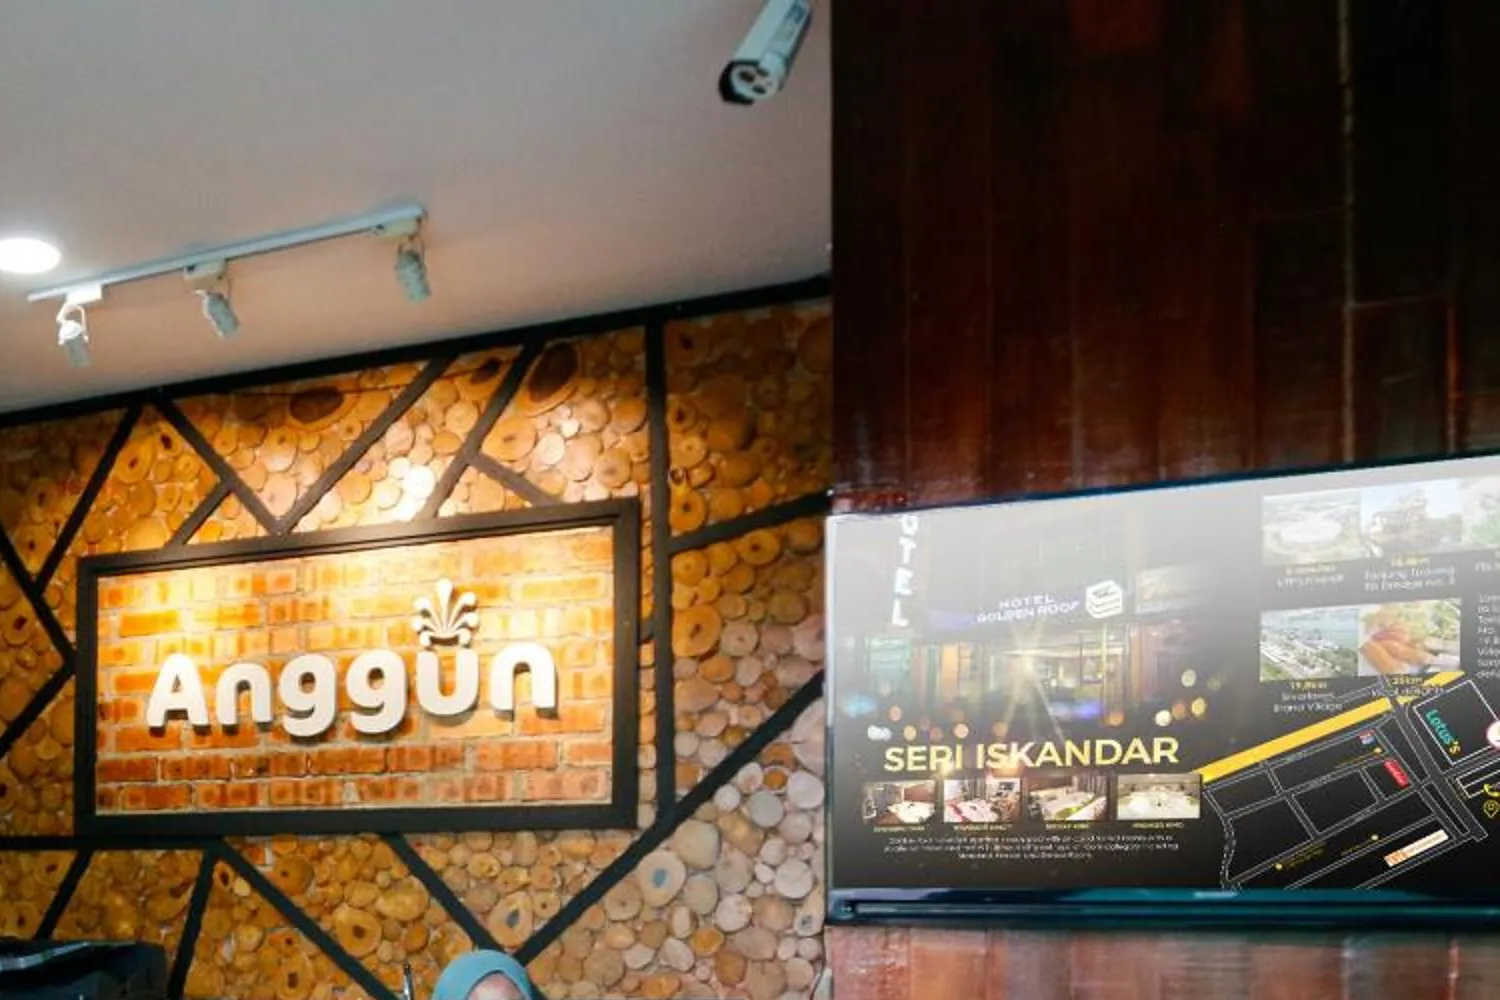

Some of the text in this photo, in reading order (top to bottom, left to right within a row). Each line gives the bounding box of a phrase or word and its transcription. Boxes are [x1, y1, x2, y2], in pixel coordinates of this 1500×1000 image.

[999, 593, 1057, 609] HOTEL
[145, 641, 558, 740] Anggun
[884, 737, 1180, 772] SERI ISKANDAR
